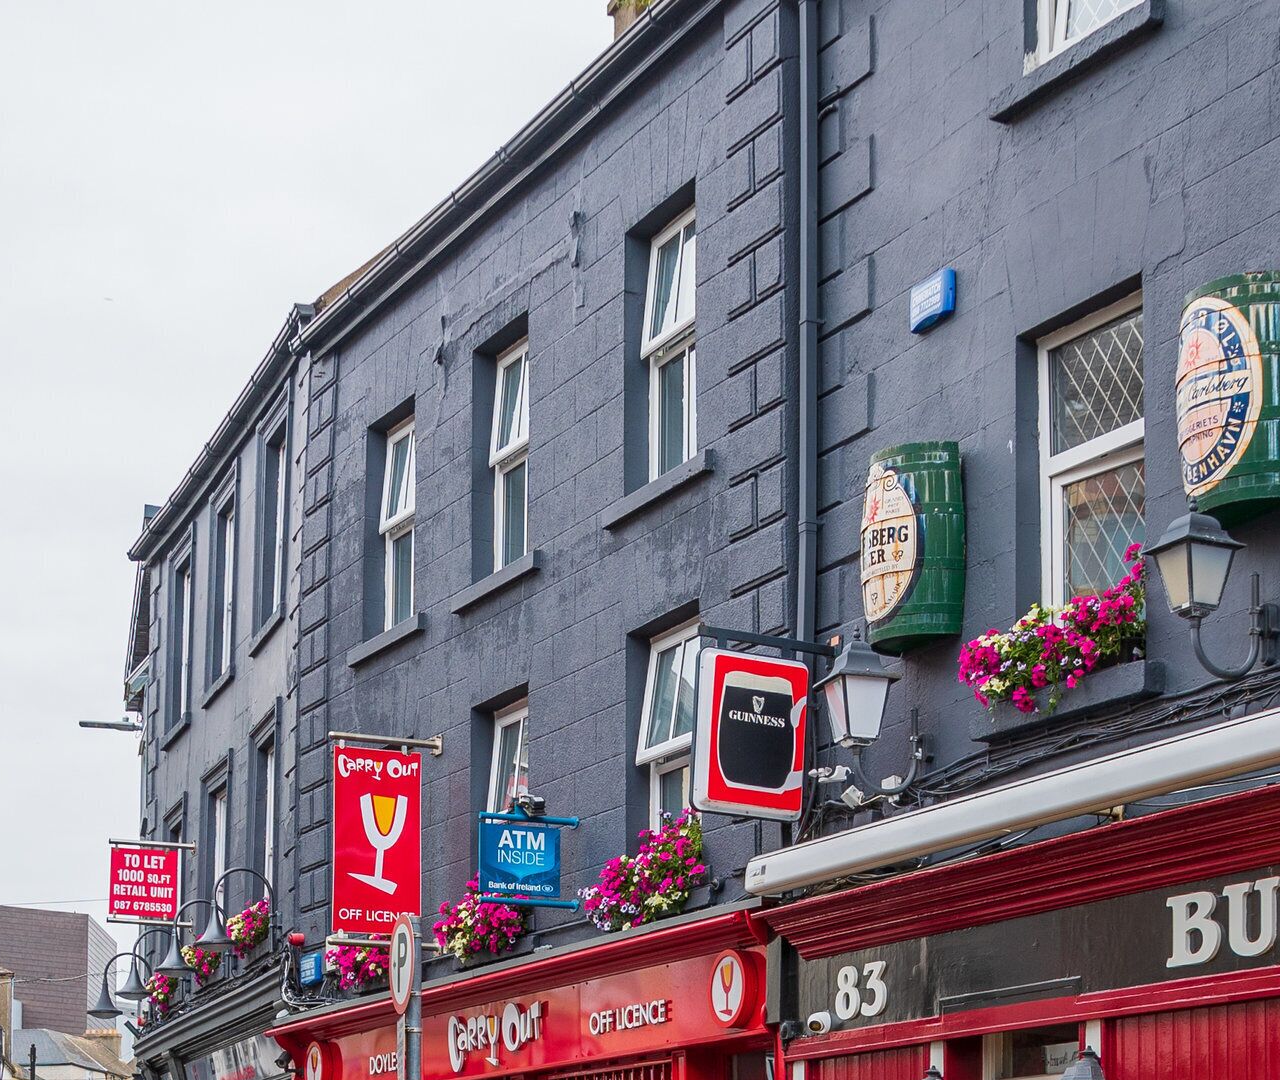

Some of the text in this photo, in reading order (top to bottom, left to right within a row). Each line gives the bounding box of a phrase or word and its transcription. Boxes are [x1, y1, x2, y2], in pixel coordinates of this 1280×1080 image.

[729, 709, 786, 728] GUINNESS
[498, 829, 545, 851] ATM
[124, 854, 165, 869] TO LET
[497, 849, 544, 866] INSIDE
[117, 869, 144, 882] 1000
[113, 884, 173, 898] RETAIL UNIT
[488, 881, 541, 892] Bank of Ireland
[114, 900, 172, 912] 087 6785530
[339, 908, 415, 922] OFF LICEN
[835, 960, 887, 1020] 83
[589, 1011, 613, 1036] OFF
[616, 999, 666, 1031] LICENCE
